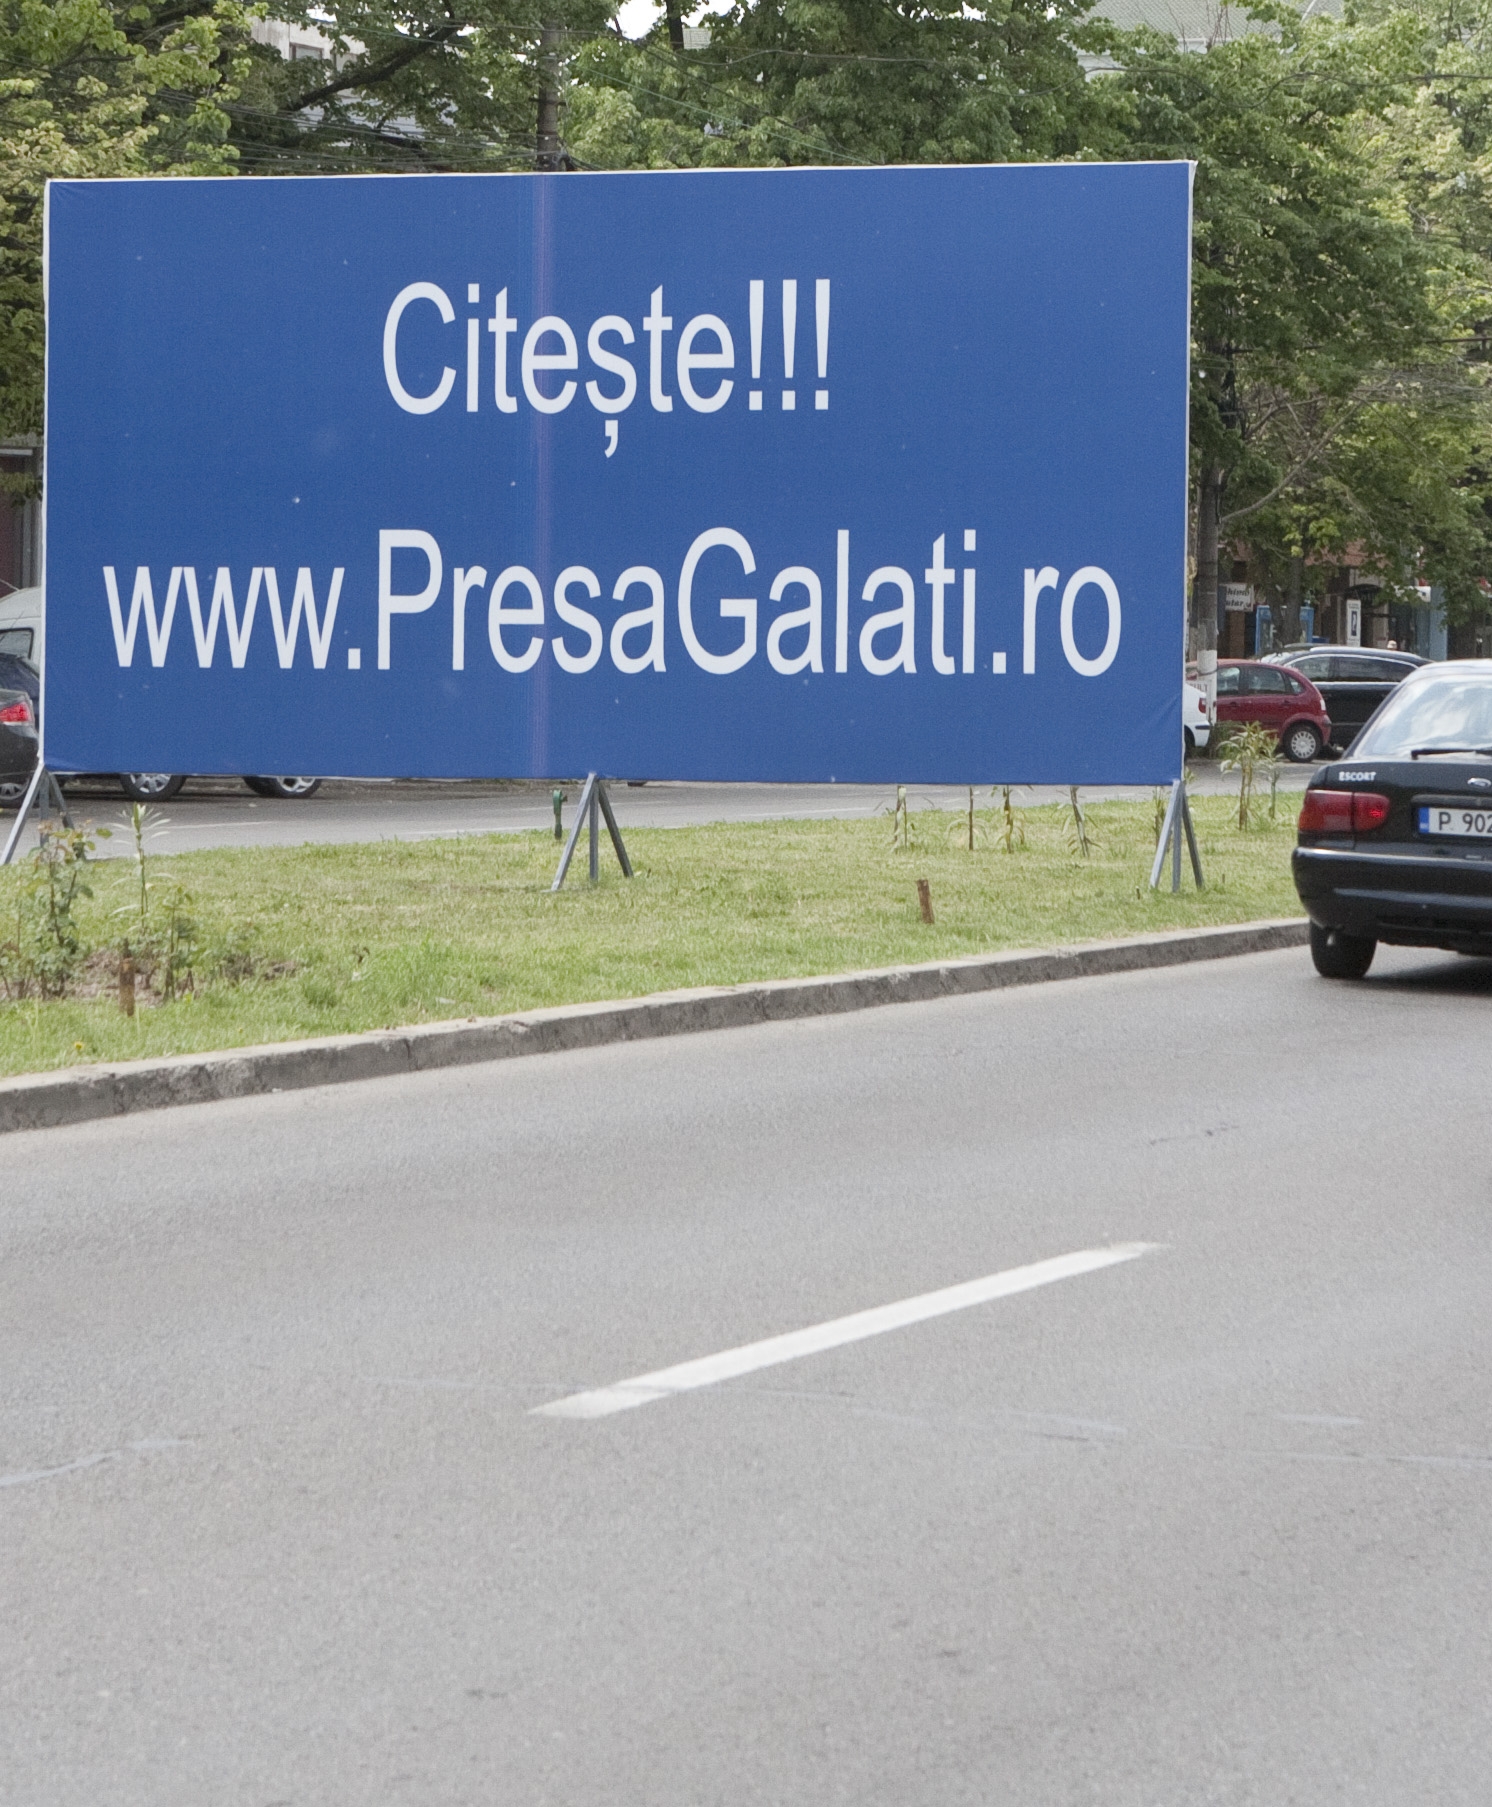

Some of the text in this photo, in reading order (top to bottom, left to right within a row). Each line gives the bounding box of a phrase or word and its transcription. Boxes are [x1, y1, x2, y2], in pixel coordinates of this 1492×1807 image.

[383, 278, 831, 458] Citește!!!
[103, 526, 1122, 677] www.PresaGalati.ro
[1339, 771, 1377, 782] ESCORT
[1438, 811, 1451, 831] P
